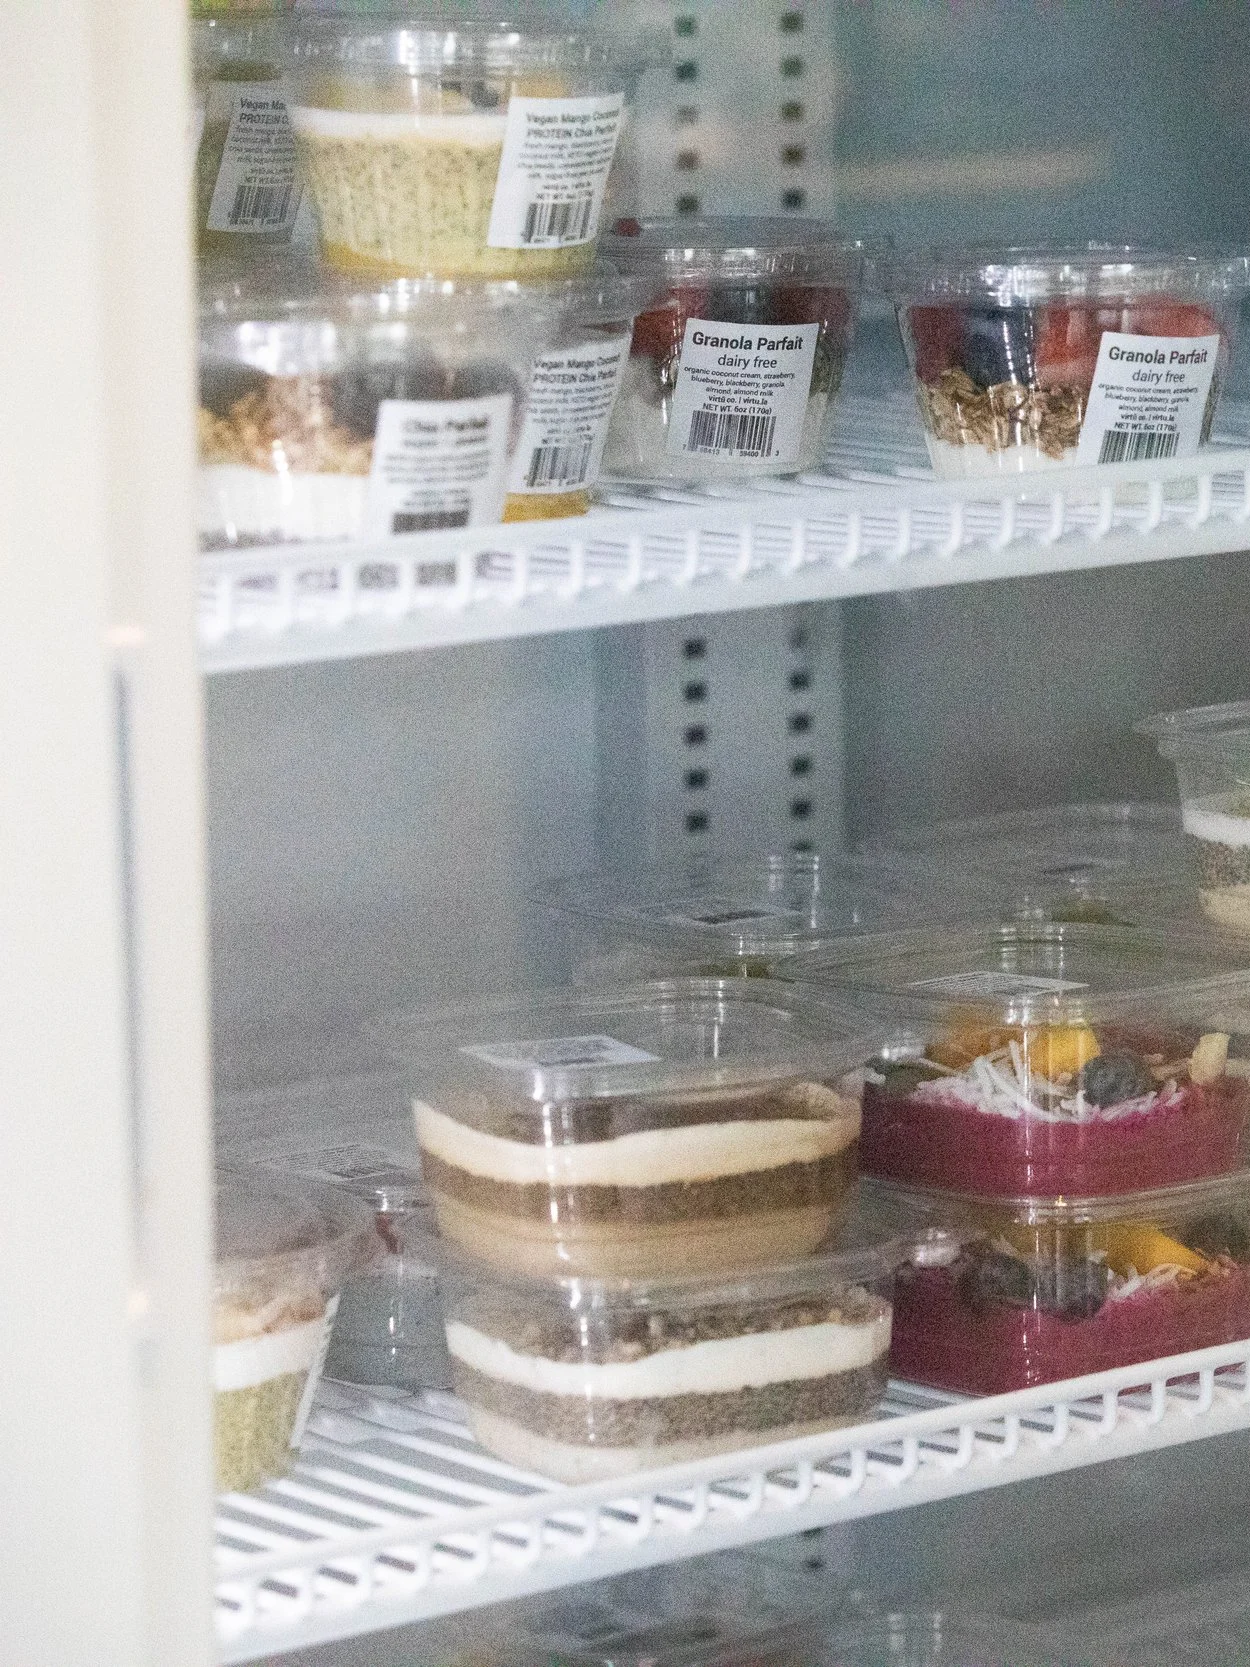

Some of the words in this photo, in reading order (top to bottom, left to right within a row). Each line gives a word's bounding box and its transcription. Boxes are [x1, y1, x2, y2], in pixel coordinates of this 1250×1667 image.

[240, 98, 270, 112] Vegan
[239, 113, 281, 125] PROTEIN
[526, 111, 558, 126] Vegan
[561, 112, 592, 125] Mango
[527, 128, 573, 138] PROTEIN
[692, 331, 753, 351] Granola
[756, 336, 804, 351] Parfait
[1109, 346, 1165, 364] Granola
[1169, 348, 1208, 364] Parfait
[533, 358, 565, 371] Vegan
[567, 358, 596, 370] Mango
[717, 354, 751, 370] dairy
[753, 355, 778, 368] free
[533, 373, 577, 384] PROTEIN
[578, 372, 597, 383] Chia
[684, 365, 711, 375] organic
[711, 369, 740, 379] coconut
[1132, 369, 1164, 386] dairy
[1164, 370, 1186, 383] free
[690, 375, 724, 387] blueberry,
[733, 388, 759, 397] almond
[1098, 383, 1124, 392] organic
[702, 403, 719, 412] NET
[733, 405, 748, 413] 6oz
[1113, 421, 1130, 430] NET
